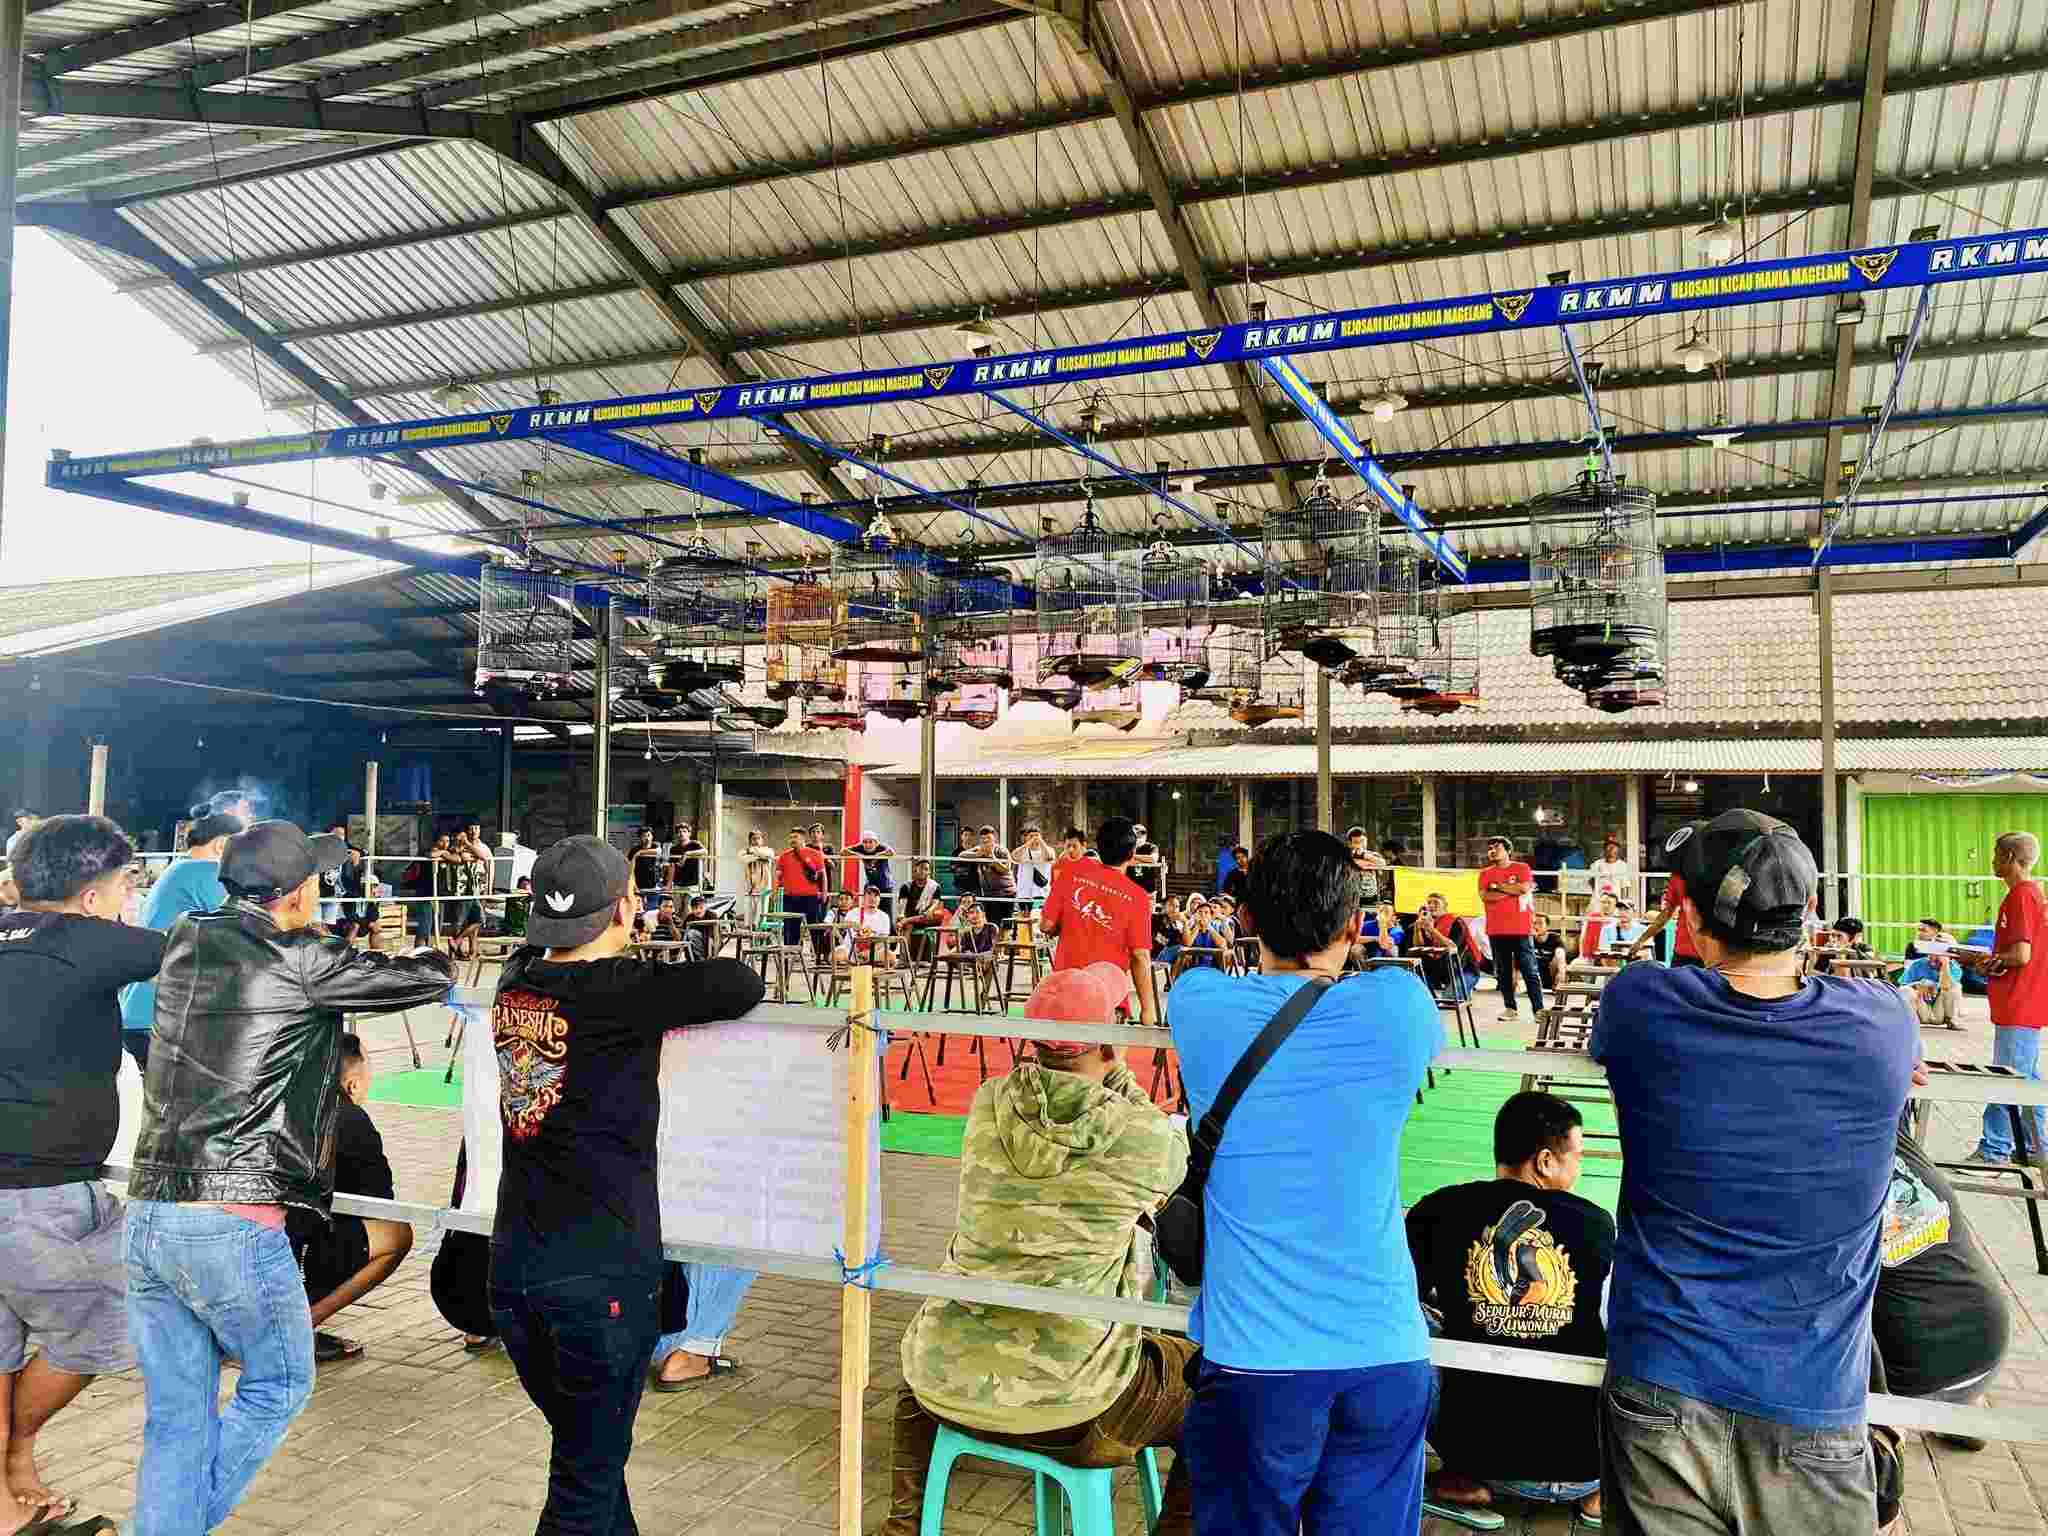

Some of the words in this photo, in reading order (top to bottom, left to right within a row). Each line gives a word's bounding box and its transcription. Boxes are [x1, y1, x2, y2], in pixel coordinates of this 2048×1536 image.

[1931, 238, 2048, 271] RKMM
[1560, 281, 1664, 313] RKMM
[1755, 269, 1790, 290] MANIA
[1245, 320, 1336, 350] RKMM
[975, 358, 1050, 383] RKMM
[738, 385, 806, 407] RKMM
[530, 408, 590, 428] RKMM
[1475, 1302, 1526, 1322] SEDULUR
[1526, 1303, 1573, 1323] MURAI
[1487, 1317, 1559, 1336] KLIWONAN
